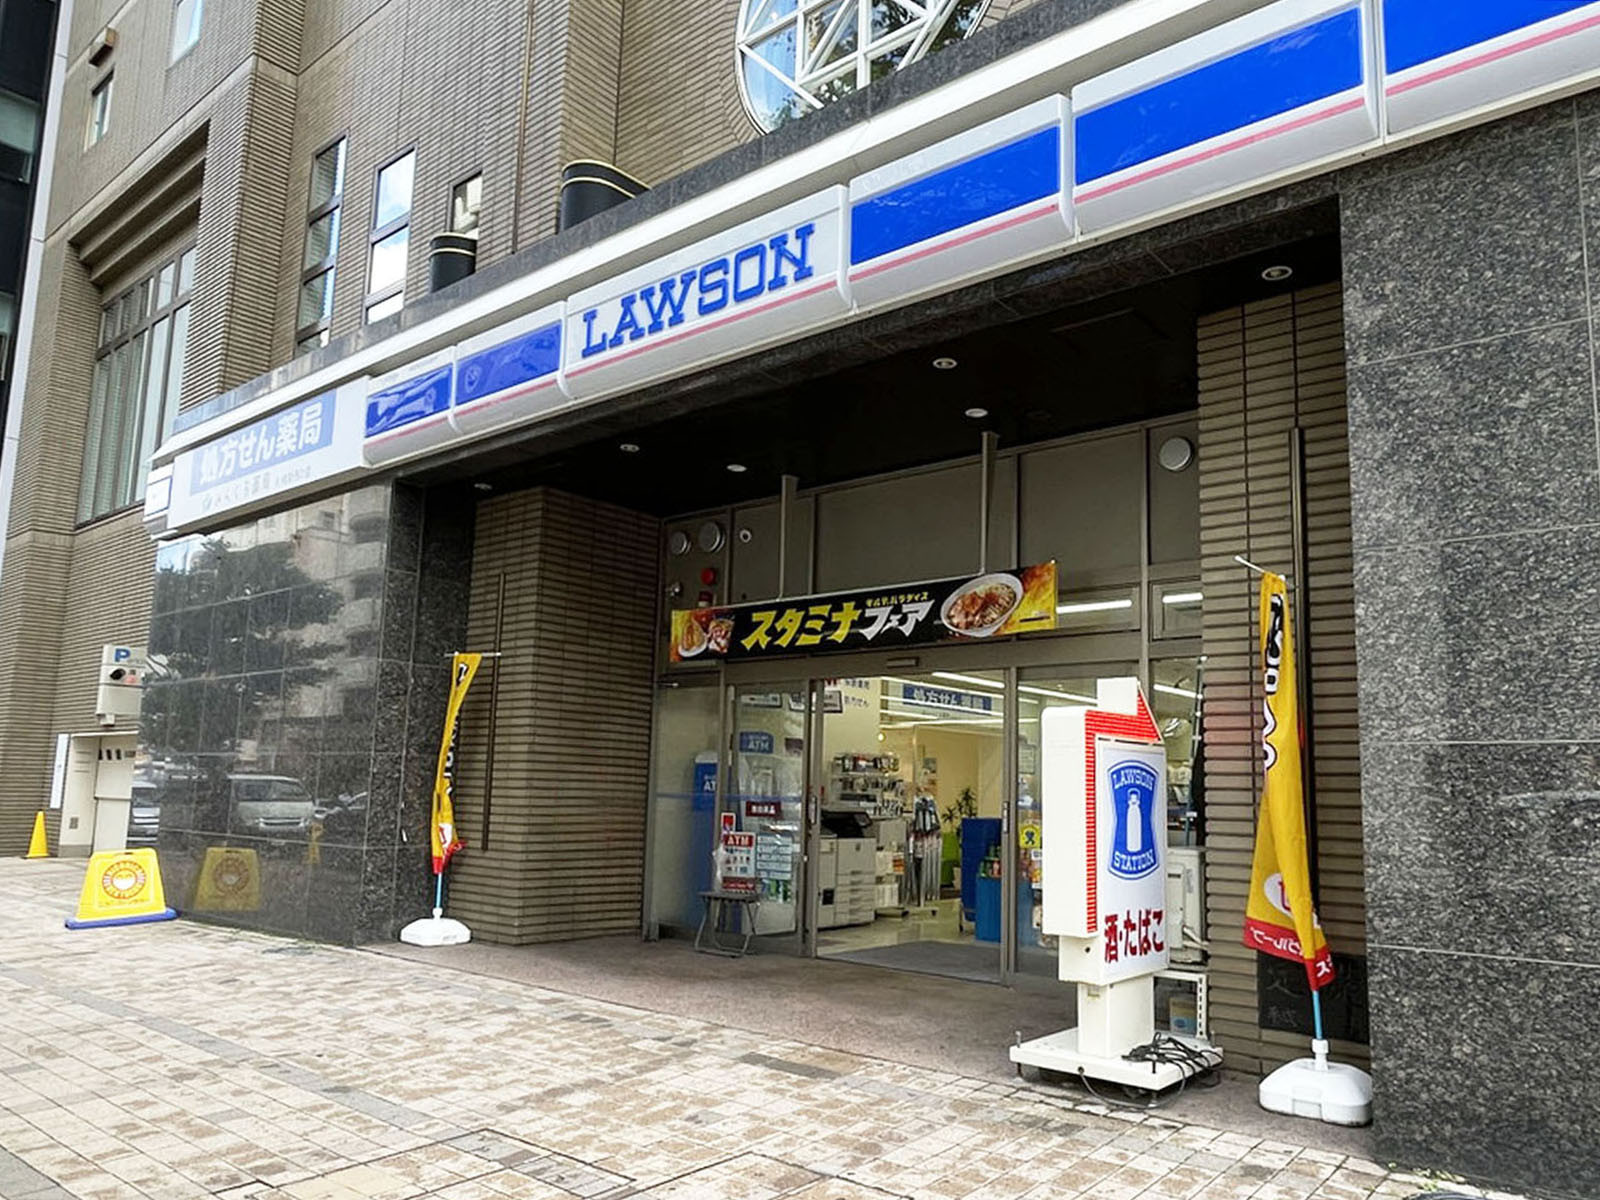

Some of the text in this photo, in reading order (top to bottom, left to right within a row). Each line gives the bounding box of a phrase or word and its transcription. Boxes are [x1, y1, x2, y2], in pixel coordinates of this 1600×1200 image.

[582, 223, 816, 358] LAWSON
[200, 402, 323, 485] 処方せん薬局
[740, 600, 935, 650] スタミナフェア
[114, 648, 131, 662] P
[748, 741, 769, 751] ATM
[704, 781, 717, 791] AT
[1112, 768, 1155, 791] LAWSON
[727, 836, 749, 846] ATM
[1113, 850, 1155, 872] STATION
